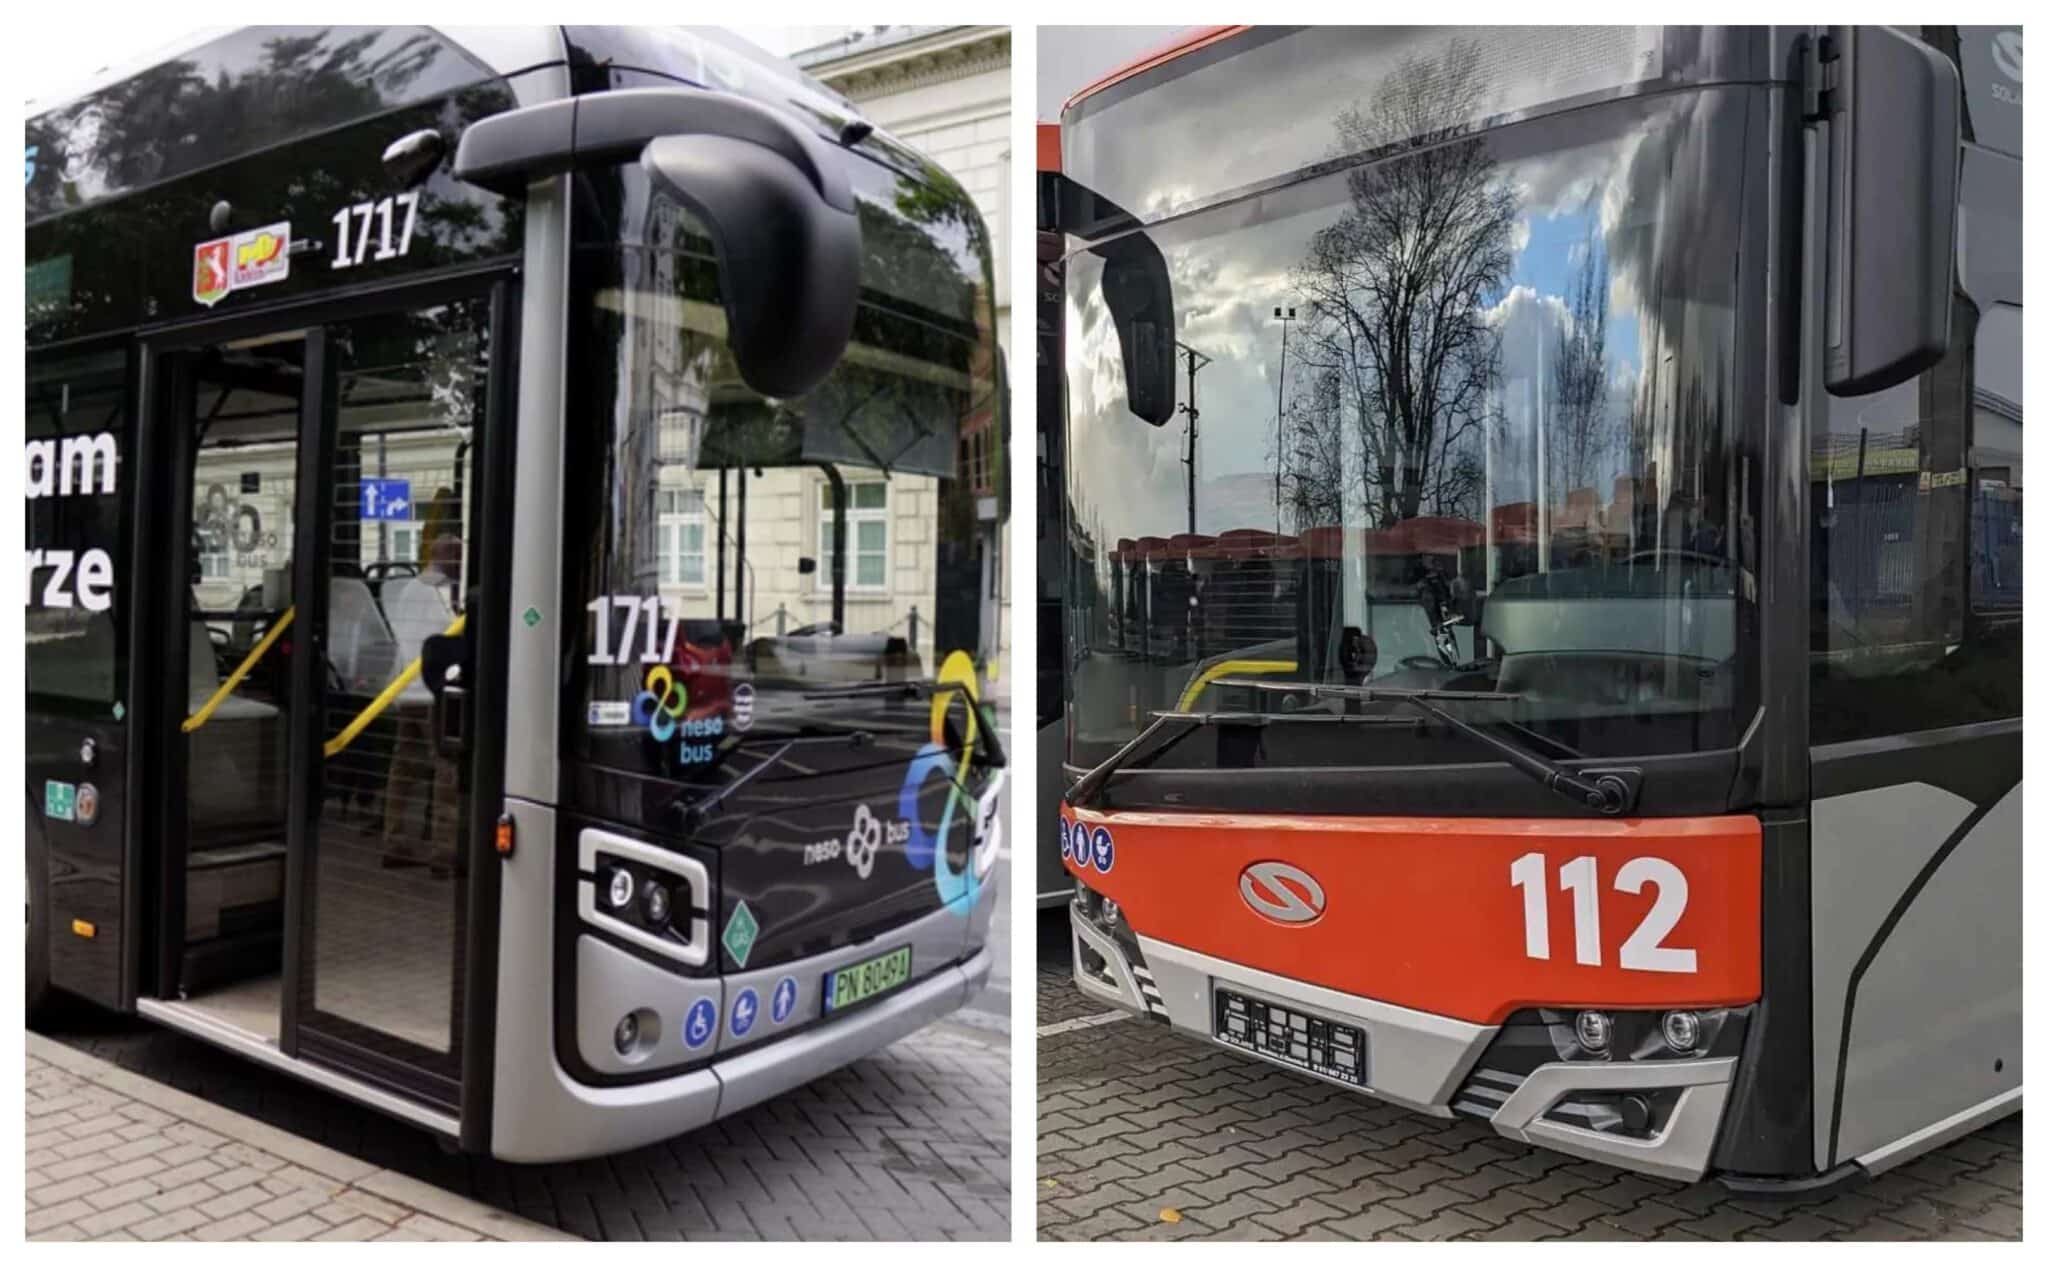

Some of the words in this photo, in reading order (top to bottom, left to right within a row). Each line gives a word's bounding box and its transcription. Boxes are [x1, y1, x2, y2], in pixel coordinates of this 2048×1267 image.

[331, 190, 419, 269] 1717
[25, 431, 116, 499] am
[25, 547, 114, 612] rze
[586, 594, 681, 665] 1717
[680, 716, 723, 738] neso
[680, 742, 713, 764] bus
[803, 837, 840, 866] neso
[887, 819, 910, 845] bus
[1511, 852, 1698, 974] 112
[836, 971, 858, 1006] PN
[863, 953, 907, 995] 8049A
